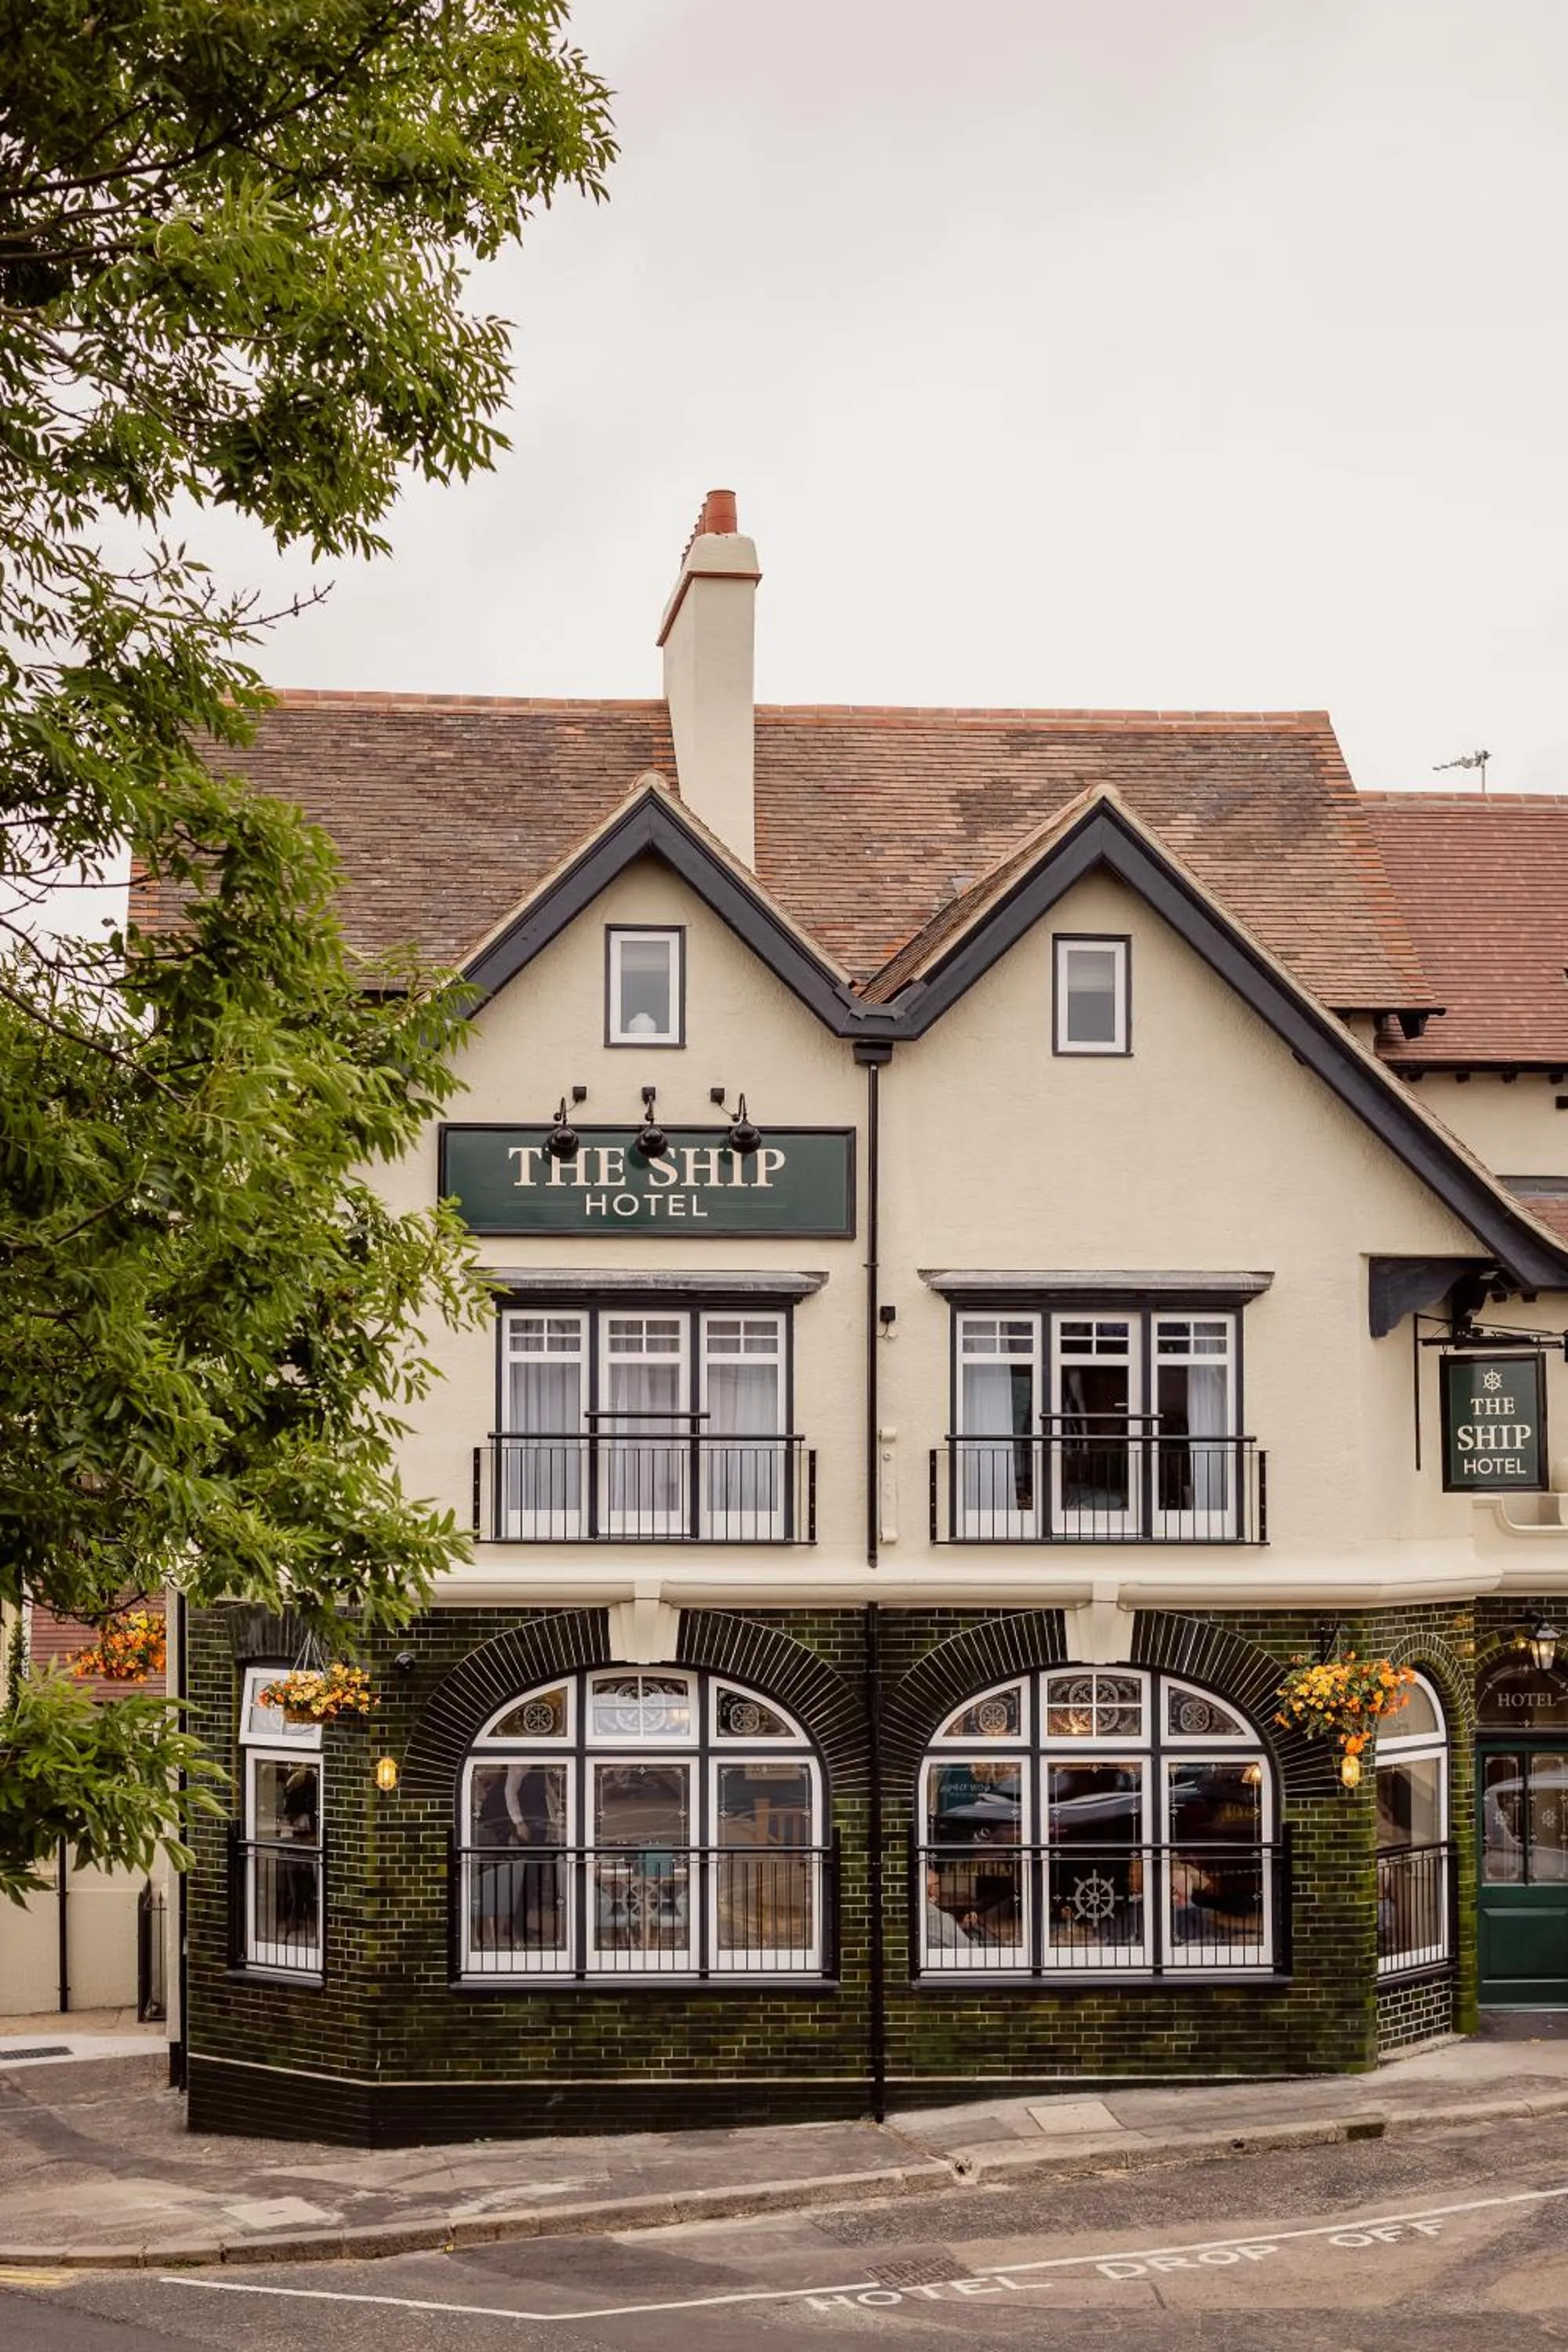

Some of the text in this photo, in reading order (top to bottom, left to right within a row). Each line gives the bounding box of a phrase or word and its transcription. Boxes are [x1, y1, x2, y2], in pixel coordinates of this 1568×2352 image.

[508, 1147, 786, 1188] THE SHIP
[585, 1193, 708, 1217] HOTEL
[1470, 1397, 1515, 1416] THE
[1457, 1424, 1531, 1451] SHIP
[1463, 1457, 1527, 1475] HOTEL
[1497, 1693, 1557, 1707] HOTEL
[804, 2219, 1443, 2310] HOTEL DROP OFF
